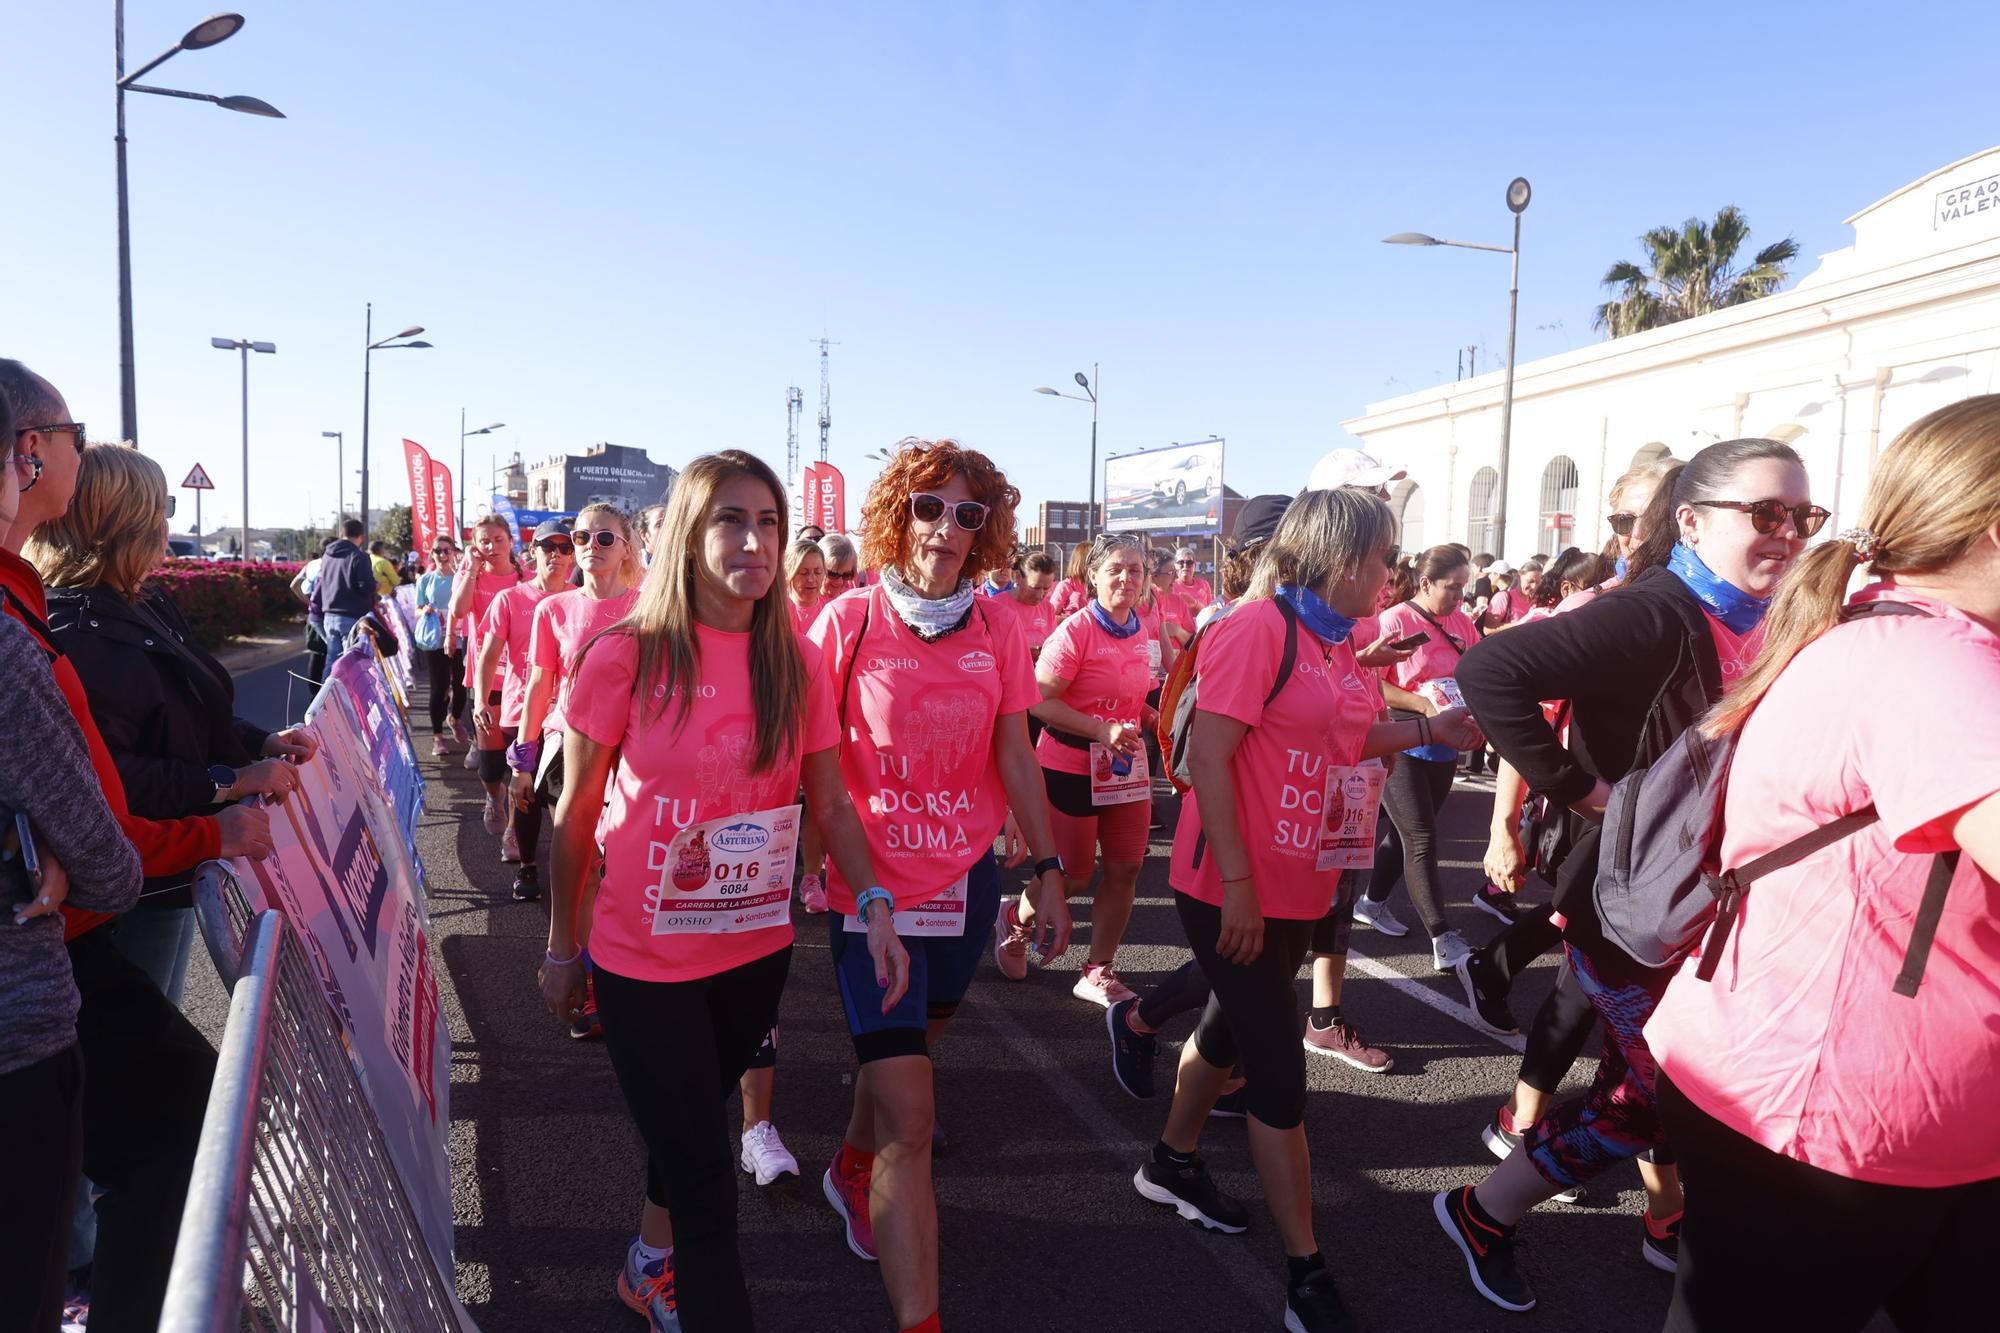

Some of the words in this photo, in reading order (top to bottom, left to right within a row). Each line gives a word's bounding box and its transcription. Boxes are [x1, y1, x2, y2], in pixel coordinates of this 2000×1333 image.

[1946, 181, 1999, 206] GRAO
[582, 466, 609, 475] PUERTO
[1097, 698, 1118, 711] TU
[875, 750, 908, 780] TU
[1286, 748, 1322, 778] TU
[654, 795, 697, 829] TU
[886, 823, 968, 850] SUMA
[714, 861, 760, 880] 016
[720, 883, 748, 895] 6084
[729, 900, 740, 908] LA
[741, 897, 765, 906] MUJER
[668, 916, 712, 926] OYSHO
[744, 908, 781, 922] Santander
[925, 919, 957, 927] Santander
